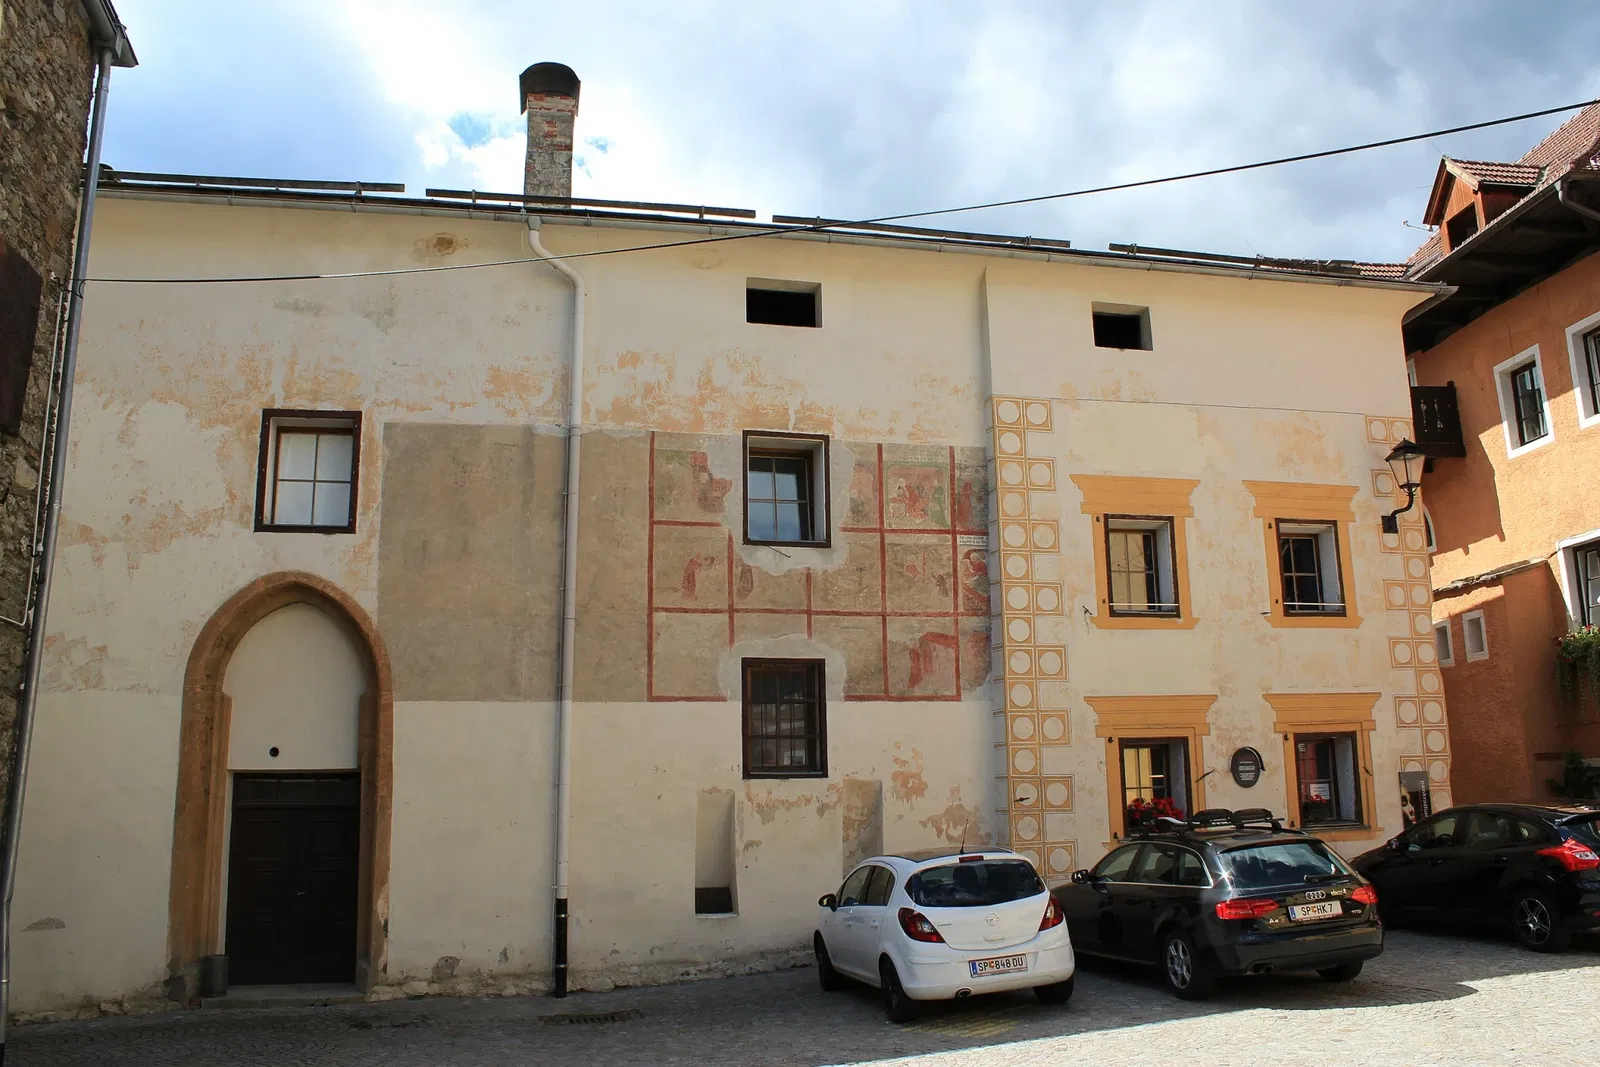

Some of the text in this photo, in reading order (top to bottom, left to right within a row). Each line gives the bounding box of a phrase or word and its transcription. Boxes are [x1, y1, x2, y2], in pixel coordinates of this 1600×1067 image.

[1301, 904, 1333, 916] SP HK 7
[978, 961, 989, 972] SP
[995, 959, 1011, 969] 848
[1013, 957, 1023, 967] DU
